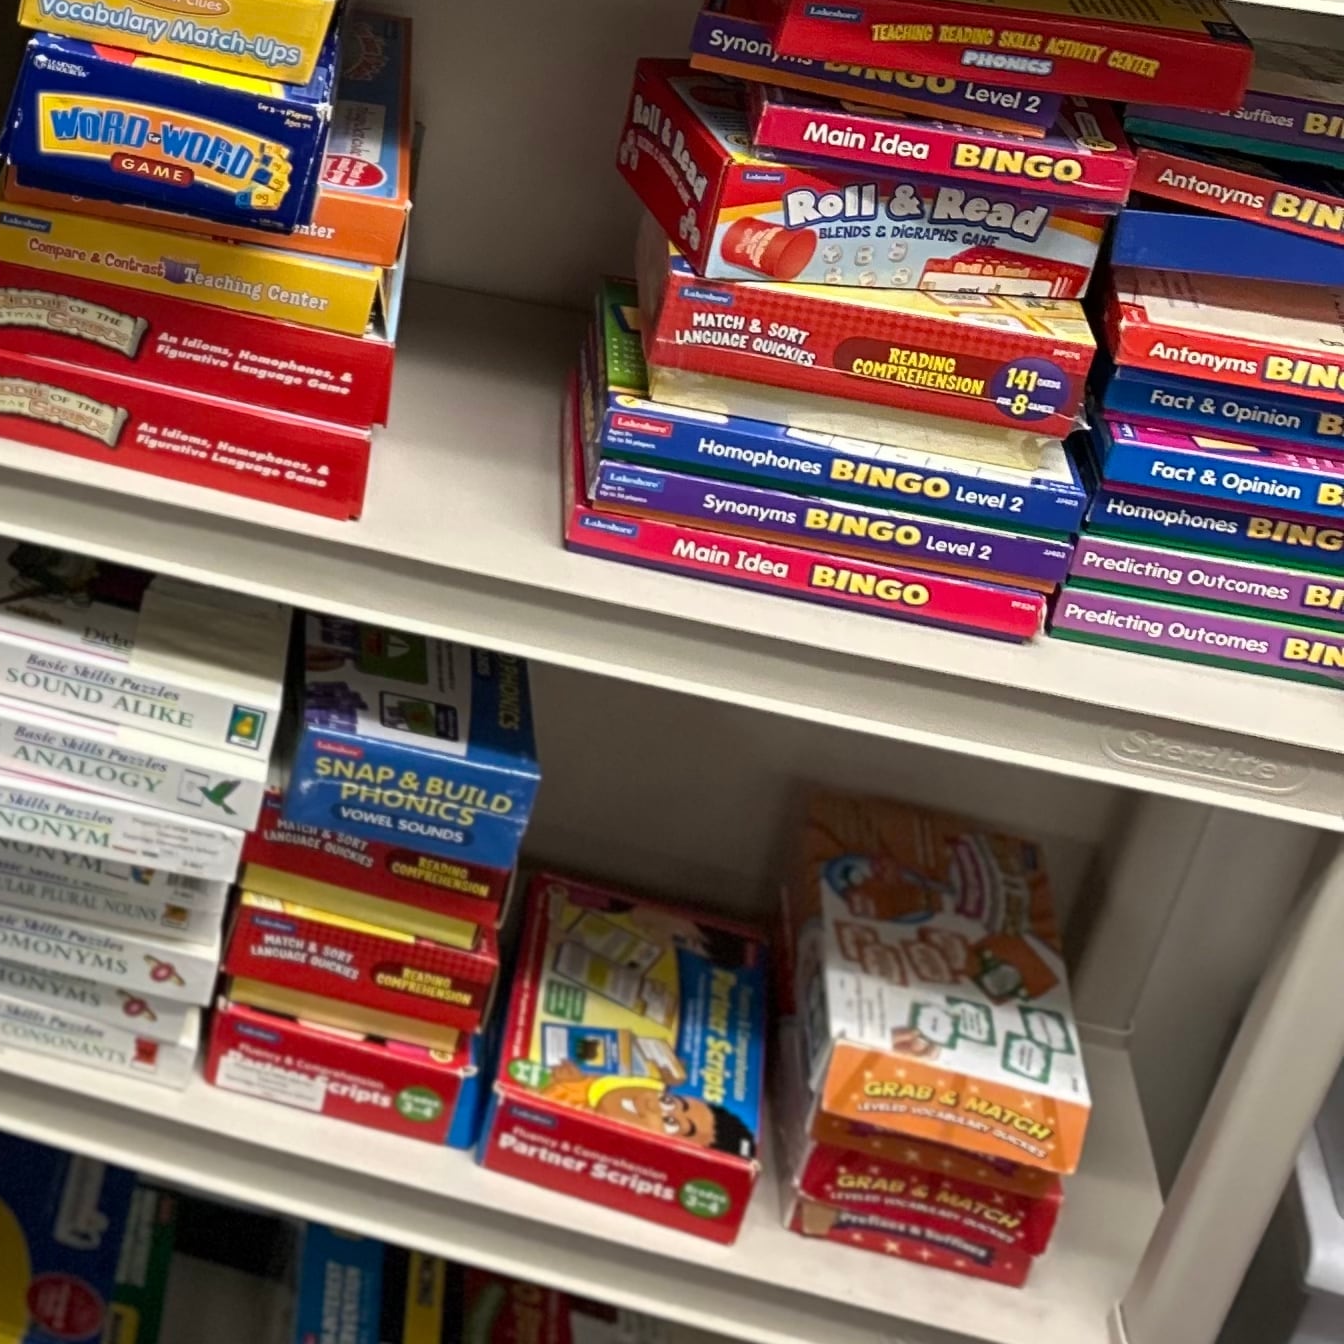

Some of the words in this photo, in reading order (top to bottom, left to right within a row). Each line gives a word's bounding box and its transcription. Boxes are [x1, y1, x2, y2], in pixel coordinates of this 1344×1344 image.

[170, 18, 301, 67] Match-Ups
[784, 183, 876, 228] Roll
[889, 185, 925, 219] &
[931, 186, 1048, 242] Read
[28, 237, 87, 264] Compare
[89, 251, 101, 264] &
[104, 253, 166, 280] Contrast
[184, 265, 265, 301] Teaching
[268, 283, 329, 313] Center
[675, 330, 747, 354] LANGUAGE
[751, 337, 816, 366] QUICKIES
[692, 313, 745, 334] MATCH
[749, 318, 763, 334] &
[768, 321, 809, 345] SORT
[852, 358, 985, 395] COMPREHENSION
[888, 347, 957, 374] READING
[1149, 342, 1258, 375] Antonyms
[698, 437, 822, 477] Homophones
[830, 459, 950, 498] BINGO
[956, 485, 1002, 509] Level
[1009, 496, 1024, 513] 2
[1151, 461, 1195, 482] Fact
[1199, 465, 1217, 484] &
[1222, 473, 1301, 501] Opinion
[672, 537, 731, 571] Main
[734, 550, 788, 578] Idea
[811, 564, 930, 606] BINGO
[1082, 551, 1182, 585] Predicting
[1187, 568, 1290, 601] Outcomes
[6, 667, 104, 704] SOUND
[111, 689, 195, 730] ALIKE
[14, 745, 165, 794] ANALOGY
[315, 757, 394, 784] SNAP
[399, 770, 421, 790] &
[426, 777, 512, 814] BUILD
[340, 782, 475, 826] PHONICS
[340, 806, 394, 827] VOWEL
[398, 818, 464, 844] SOUNDS
[863, 1079, 933, 1103] GRAB
[938, 1089, 955, 1105] &
[964, 1093, 1052, 1141] MATCH
